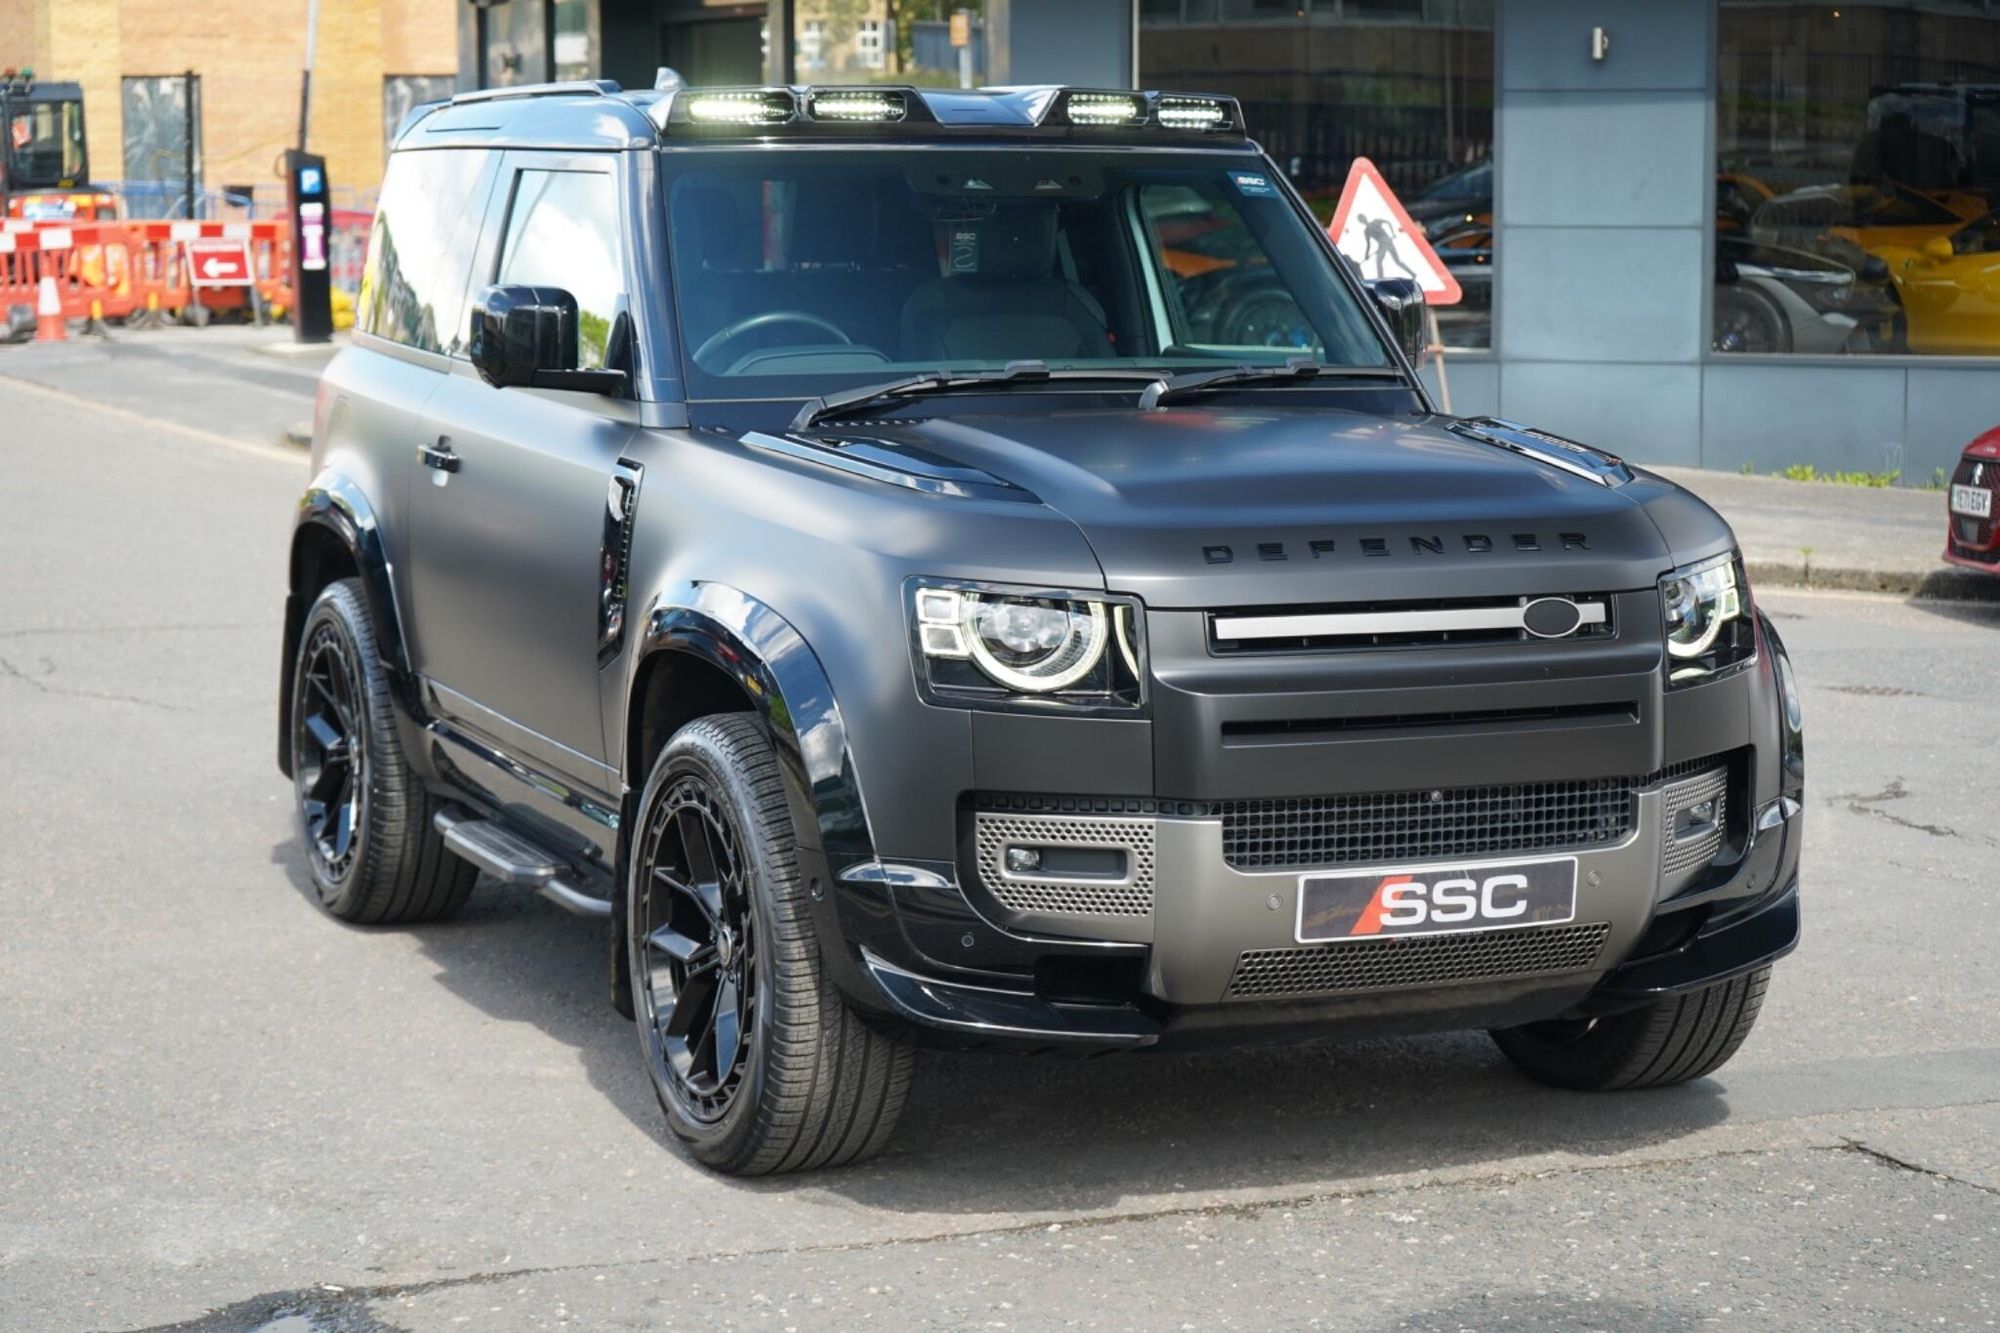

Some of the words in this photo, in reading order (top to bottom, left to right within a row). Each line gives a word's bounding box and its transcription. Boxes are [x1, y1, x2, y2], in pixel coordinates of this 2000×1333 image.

[302, 169, 320, 193] P
[1202, 532, 1592, 565] DEFENDER
[1380, 874, 1528, 926] SSC
